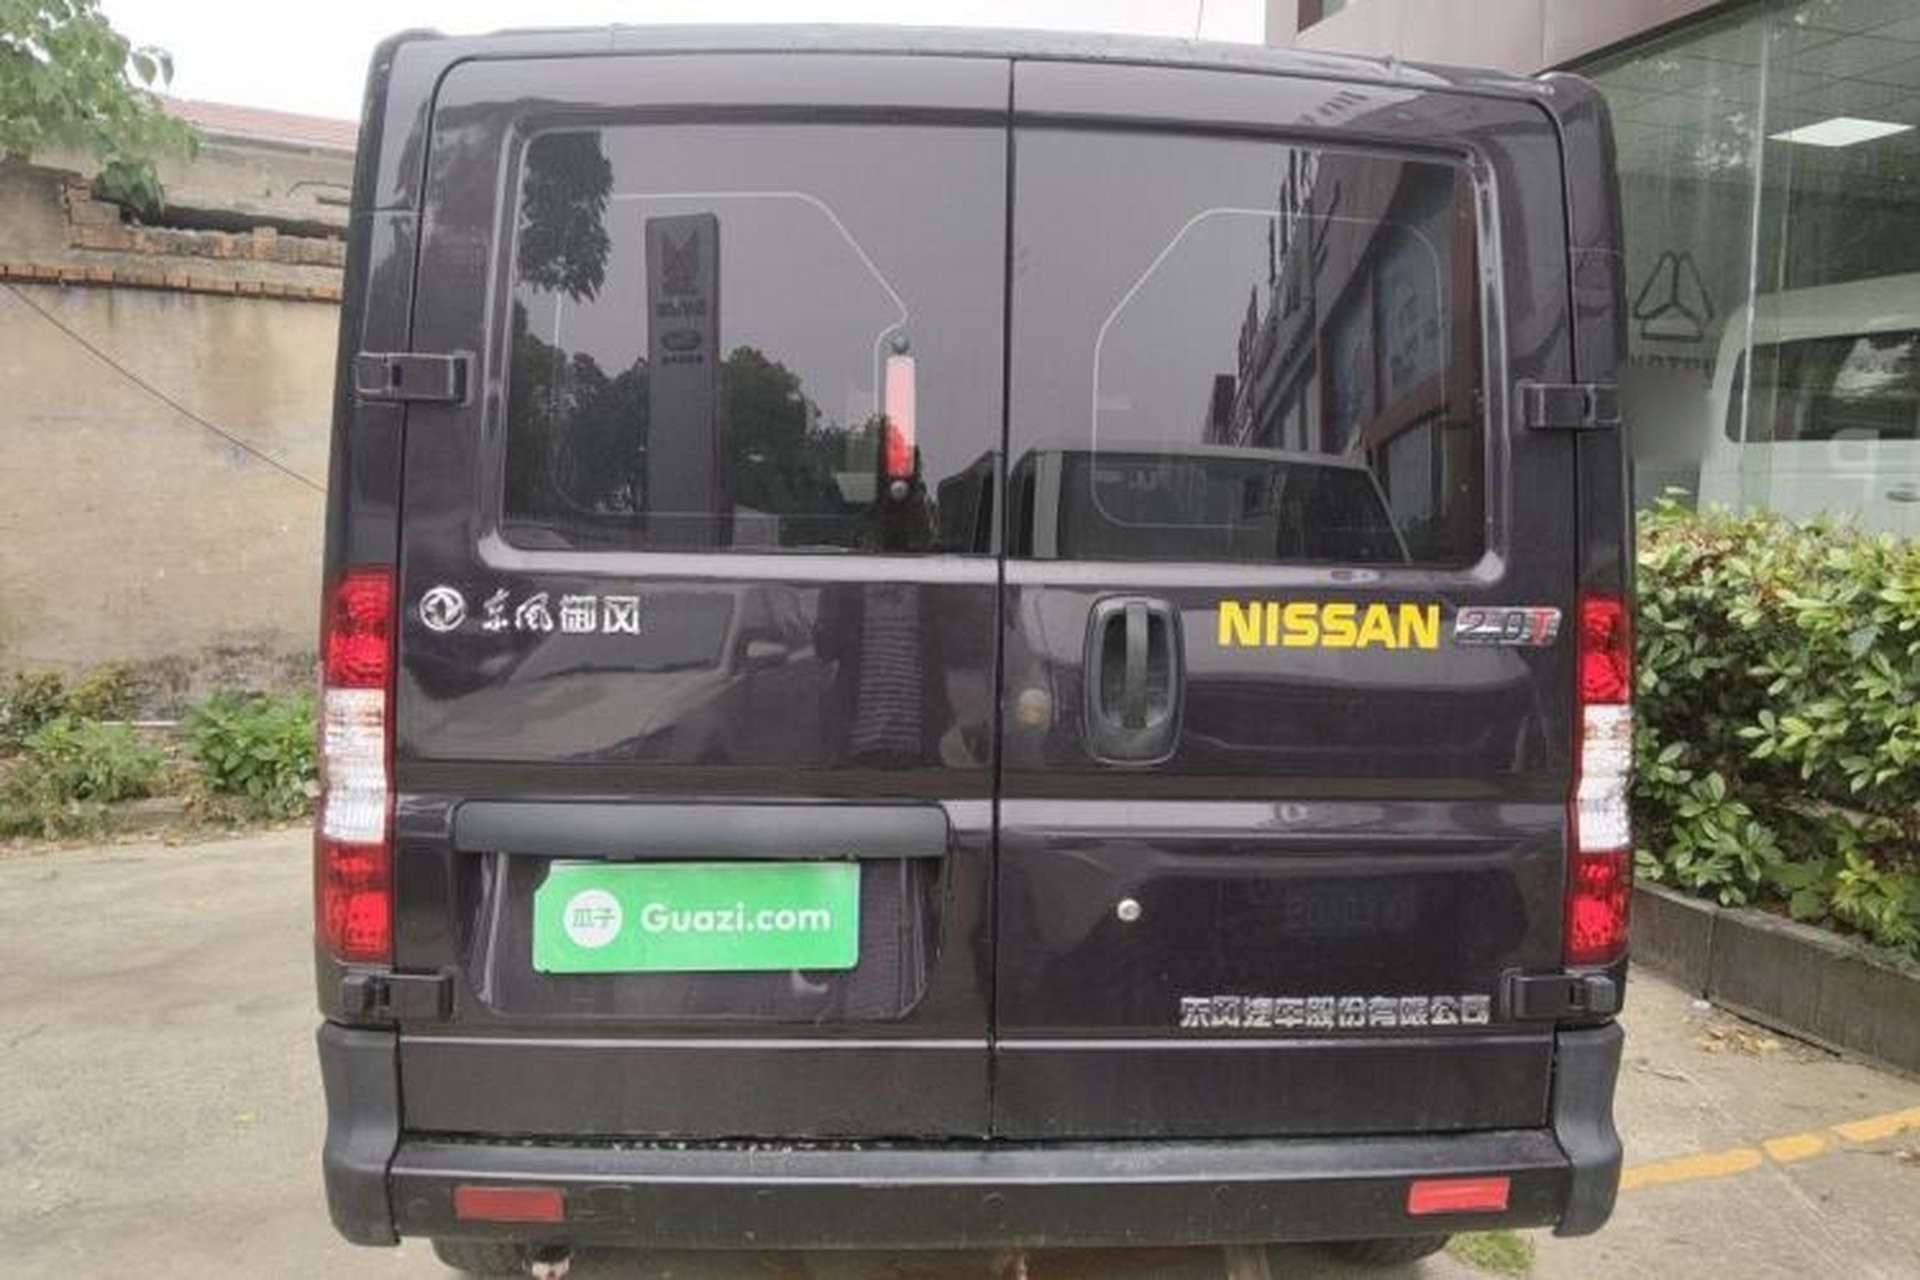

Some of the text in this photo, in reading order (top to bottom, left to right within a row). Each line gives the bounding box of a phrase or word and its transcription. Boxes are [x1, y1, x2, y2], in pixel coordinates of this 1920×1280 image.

[1218, 600, 1441, 650] NISSAN
[1179, 995, 1491, 1029] 东风汽车股份有限公司
